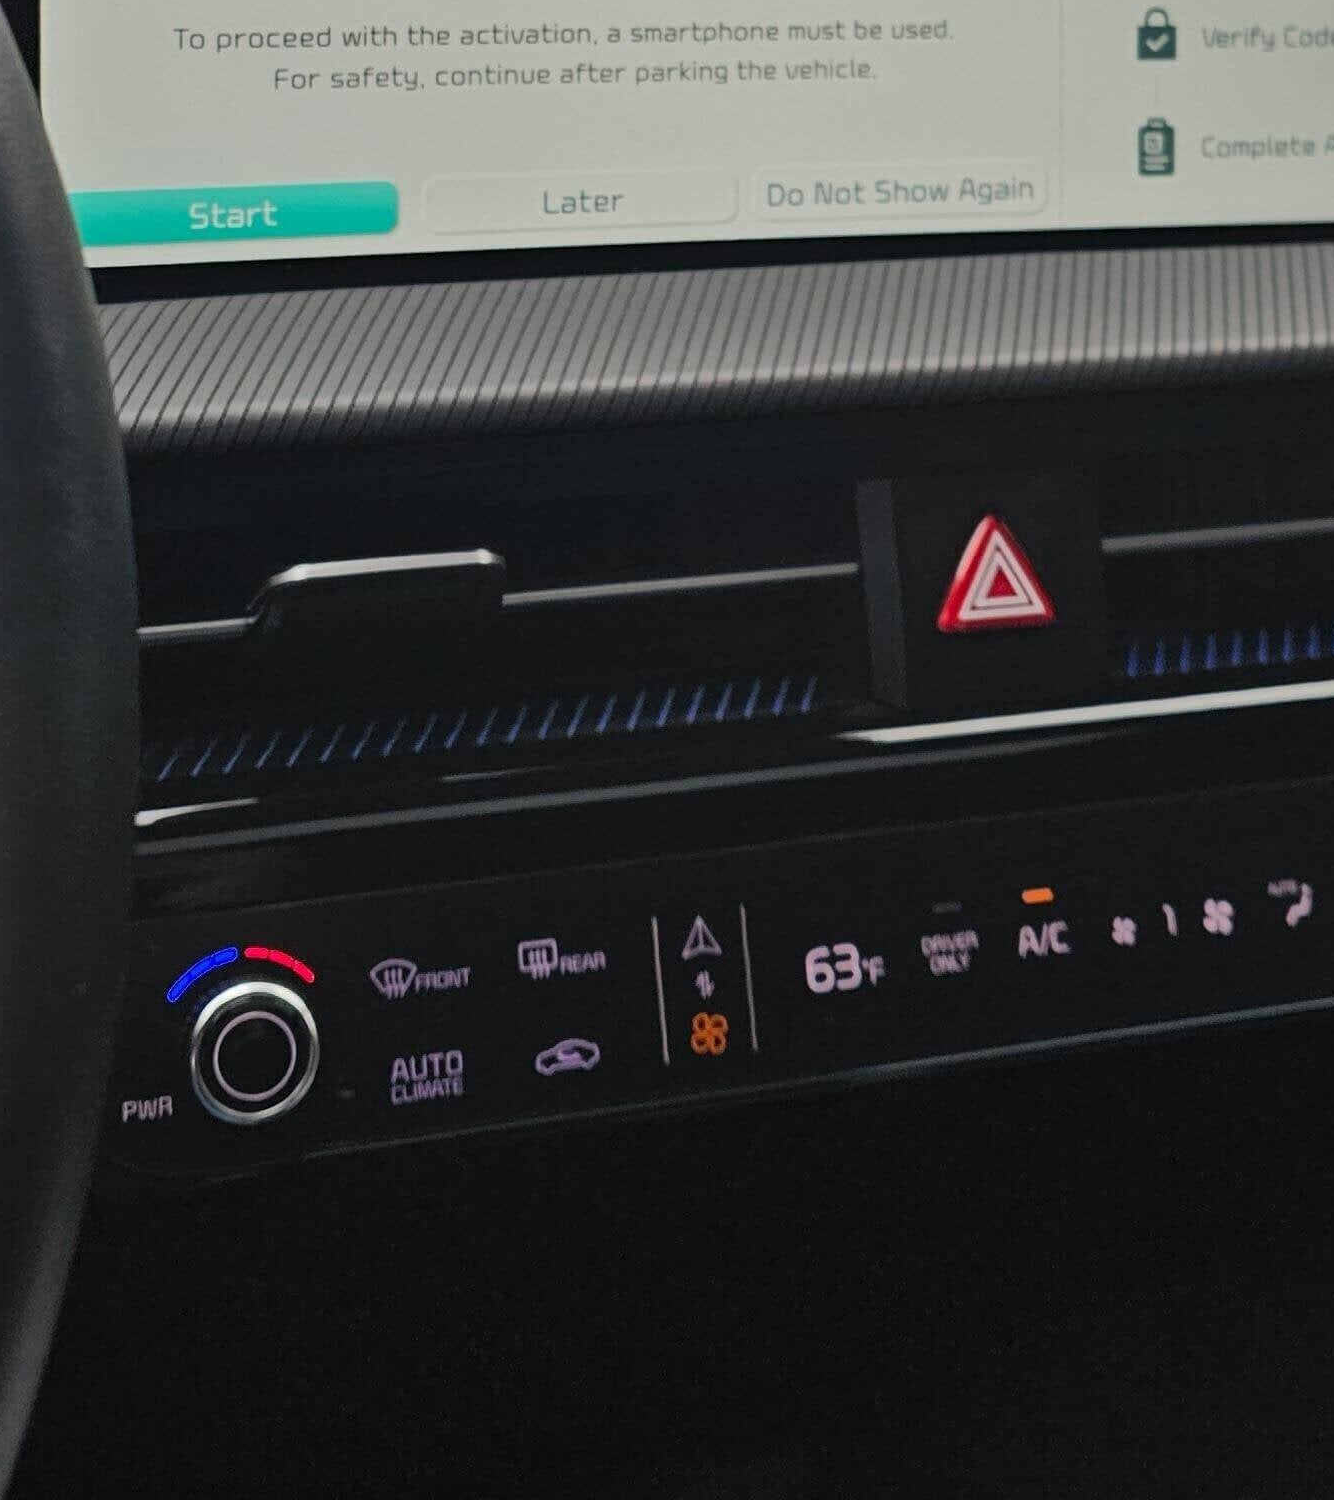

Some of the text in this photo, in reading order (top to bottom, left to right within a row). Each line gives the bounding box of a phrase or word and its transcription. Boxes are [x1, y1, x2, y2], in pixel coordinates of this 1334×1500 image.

[173, 28, 205, 50] To
[217, 27, 331, 53] proceed
[342, 26, 397, 47] with
[408, 26, 450, 46] the
[607, 28, 620, 43] a
[631, 22, 779, 45] smartphone
[788, 20, 845, 41] must
[854, 20, 882, 40] be
[891, 20, 953, 39] used.
[1202, 26, 1275, 52] Verify
[275, 58, 876, 91] For safety, continue after parking the vehicle.
[1201, 135, 1317, 160] Complete
[544, 190, 624, 214] Later
[768, 177, 1034, 207] Do Not Show Again
[187, 200, 278, 230] Start
[1019, 921, 1070, 958] A/C
[560, 951, 606, 975] REAR
[416, 967, 471, 991] FRONT
[391, 1050, 464, 1083] AUTO
[390, 1077, 465, 1105] CLIMATE
[122, 1096, 172, 1122] PWR
